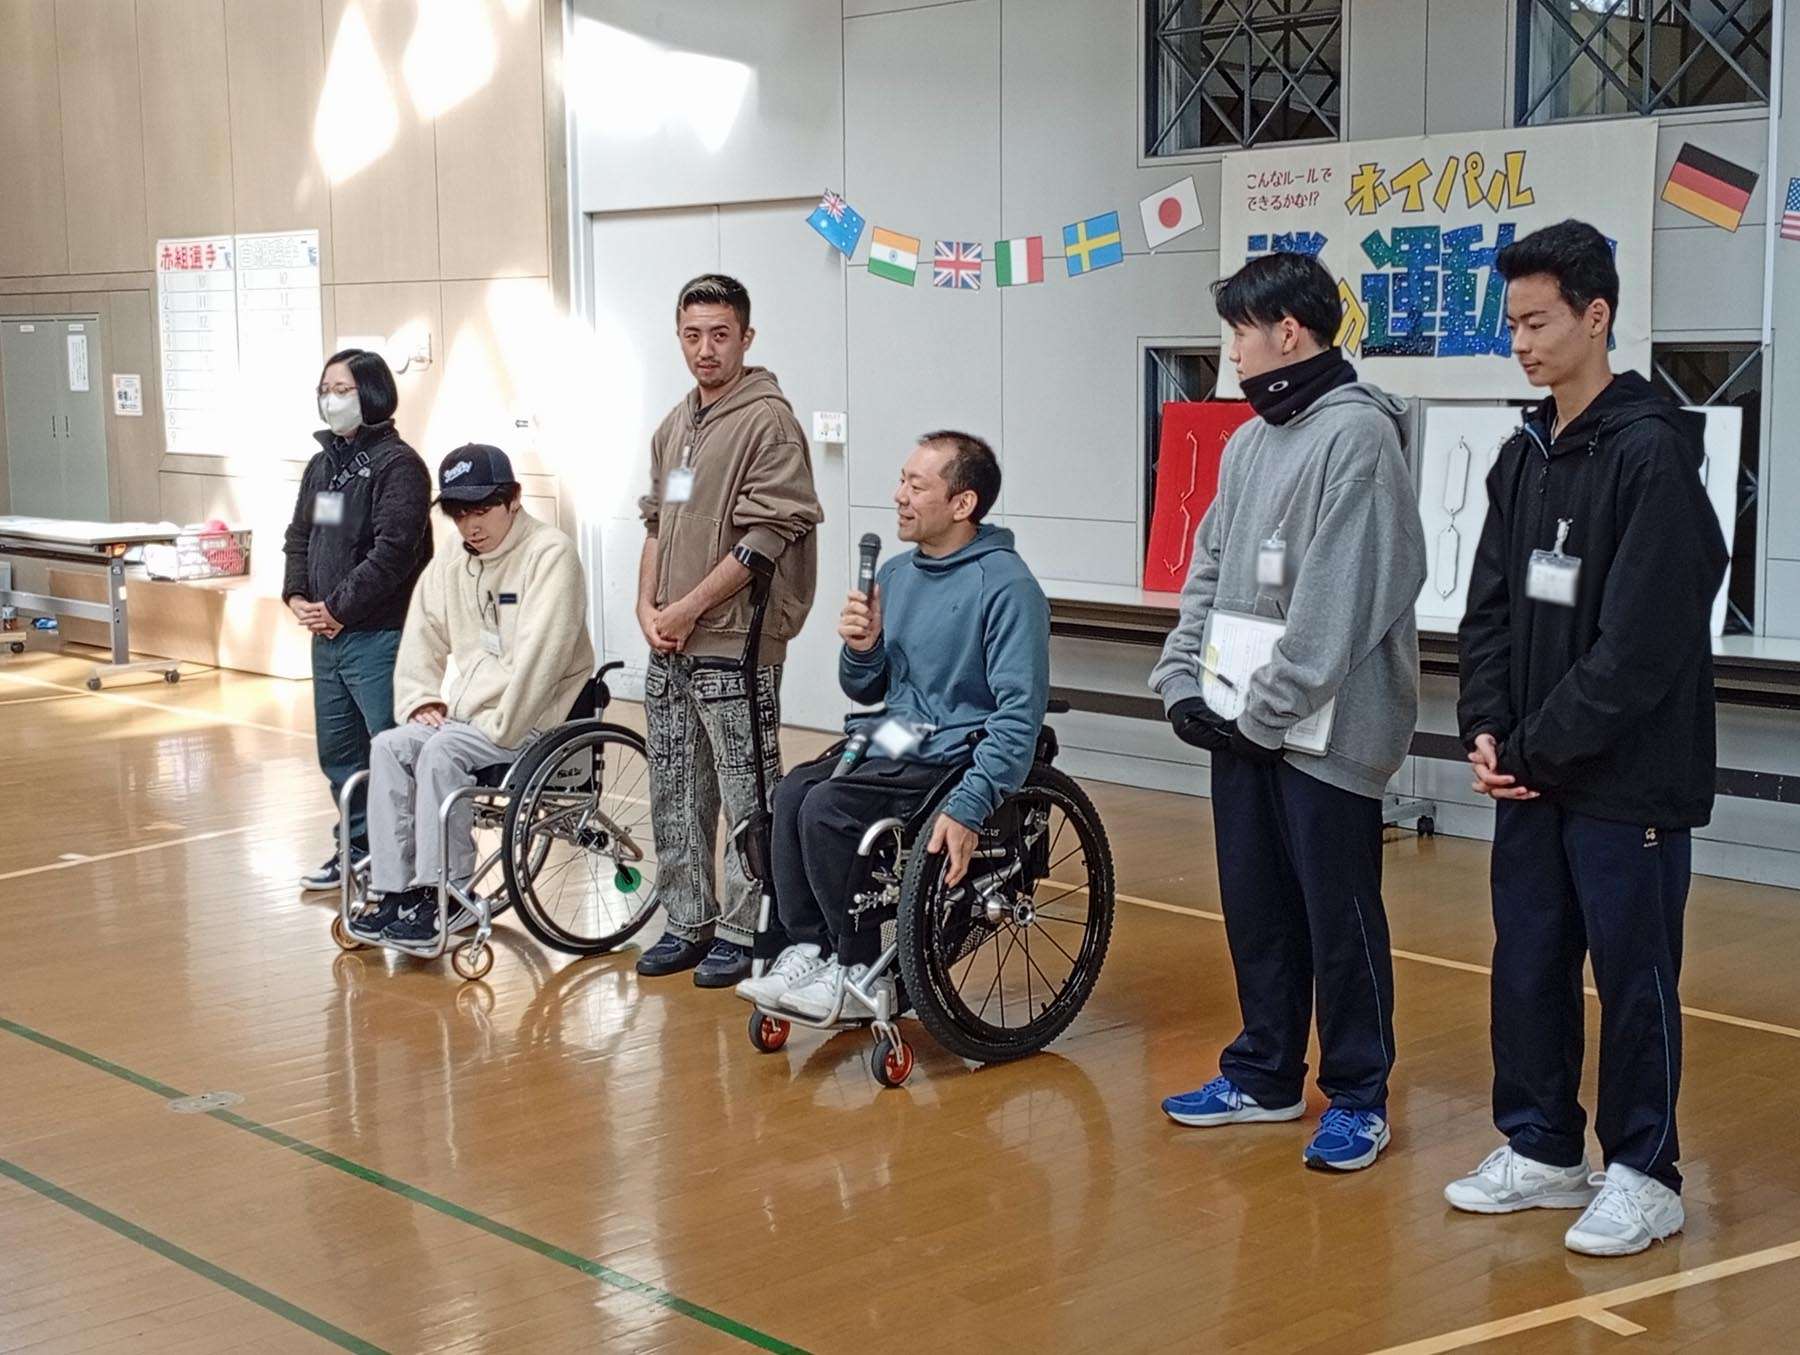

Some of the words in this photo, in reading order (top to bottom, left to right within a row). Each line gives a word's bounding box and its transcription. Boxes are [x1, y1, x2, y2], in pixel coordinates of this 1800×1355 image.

[1247, 167, 1332, 189] こんなルールで
